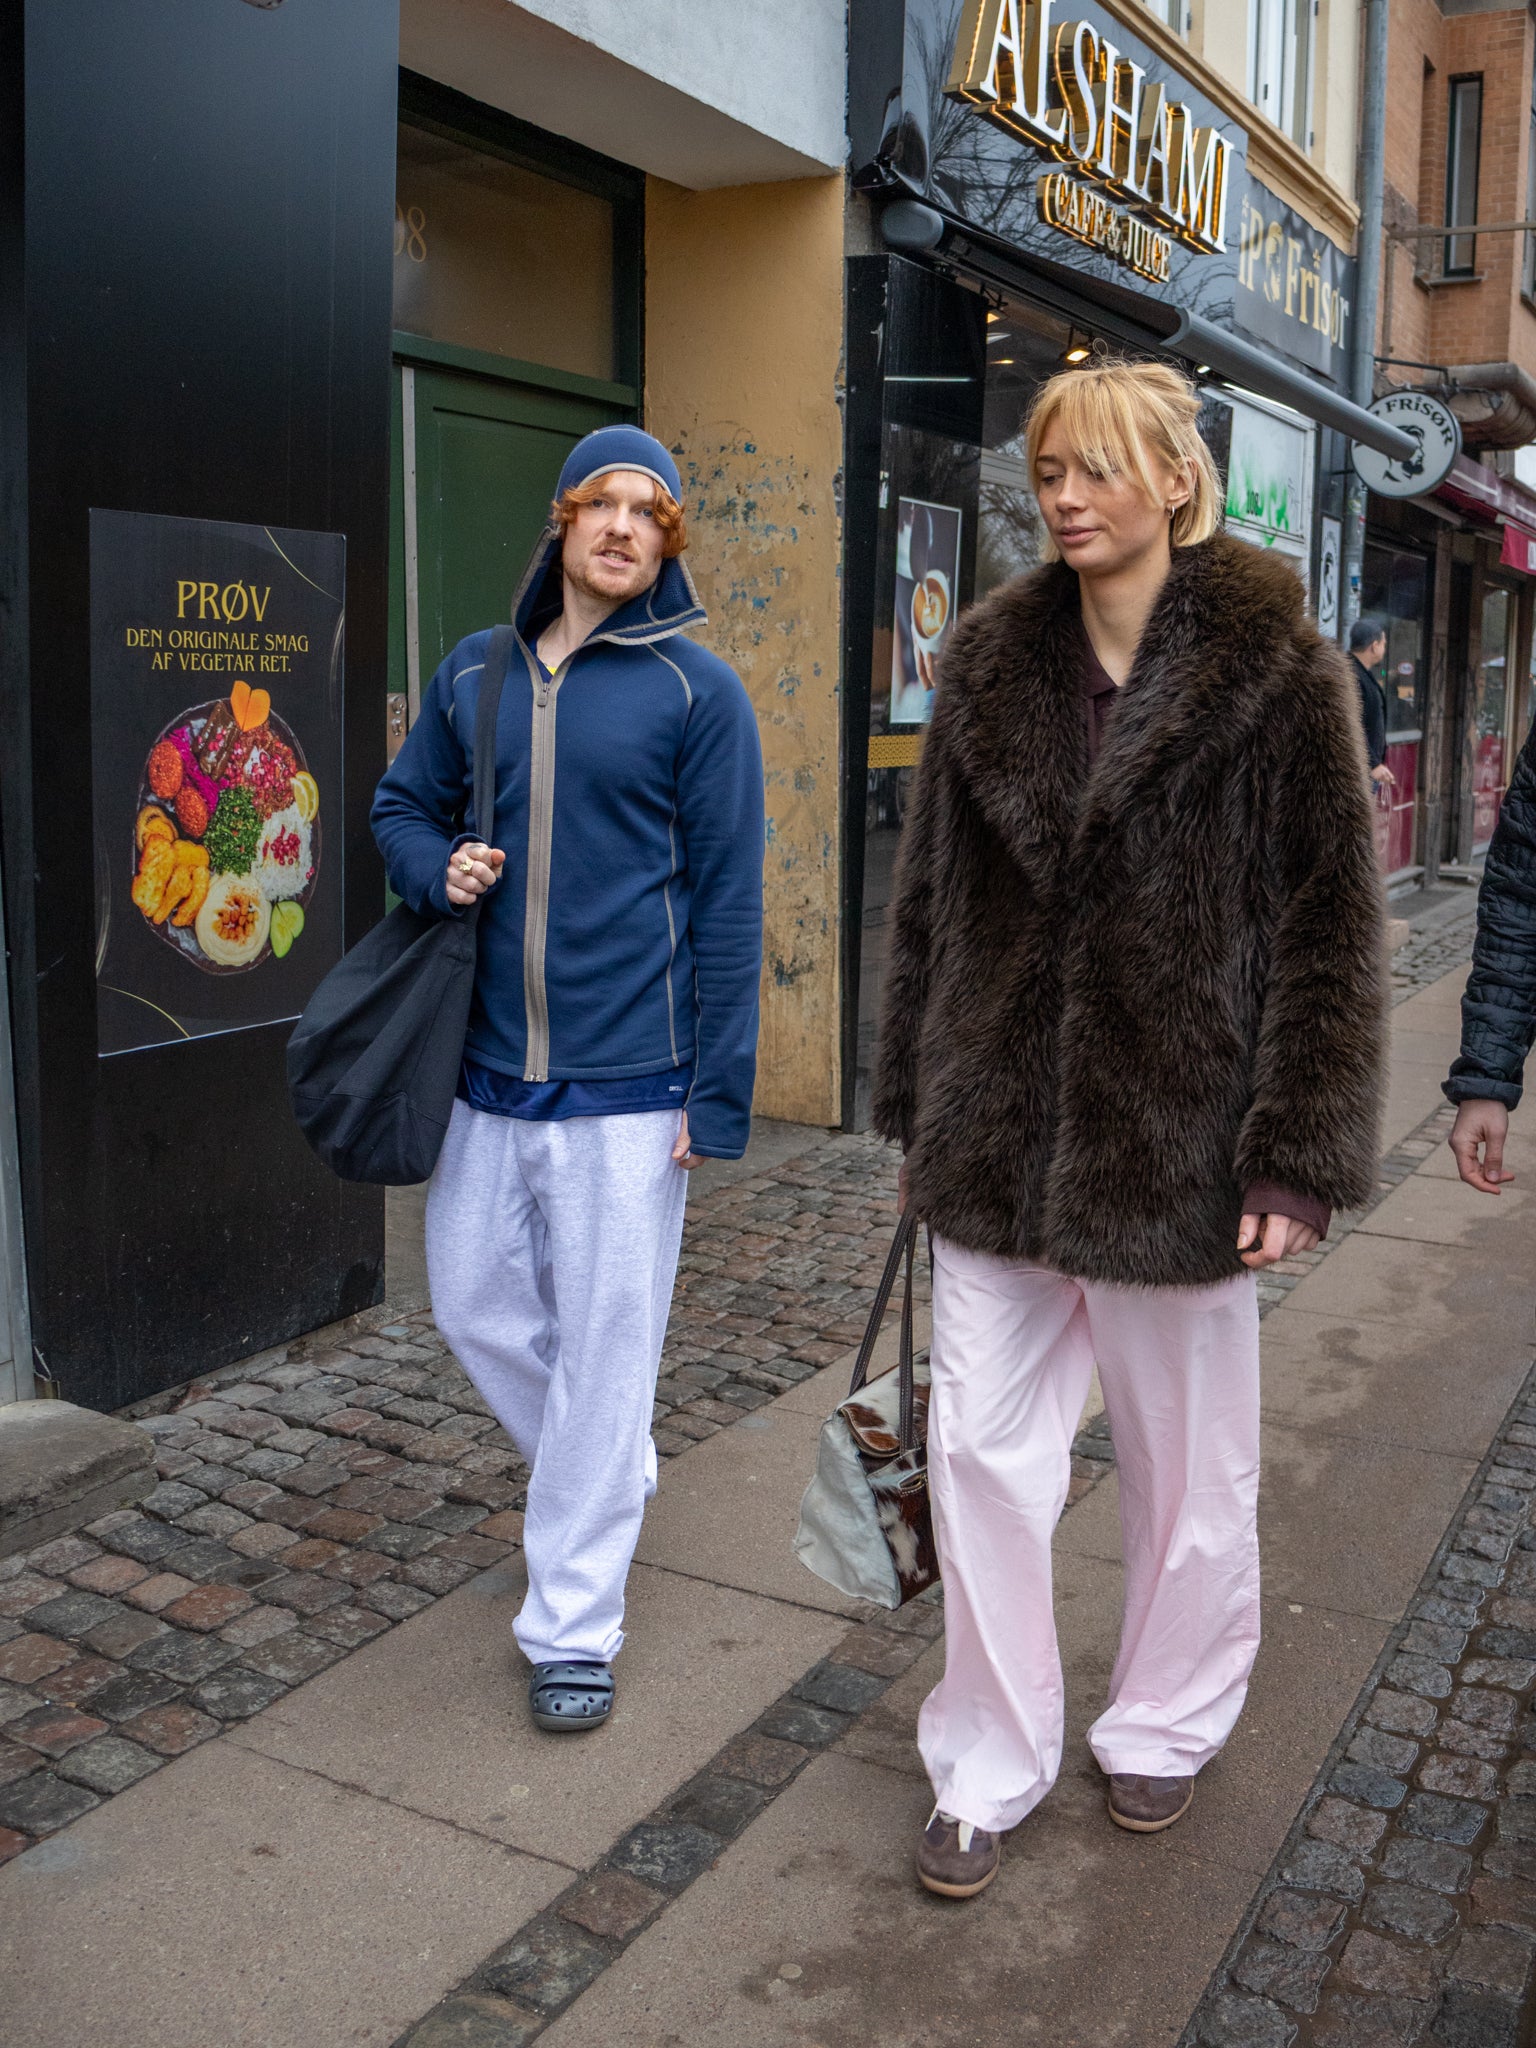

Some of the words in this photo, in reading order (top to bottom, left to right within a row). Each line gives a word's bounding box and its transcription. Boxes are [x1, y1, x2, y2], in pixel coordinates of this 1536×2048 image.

[979, 0, 1235, 254] ALSHAMI
[1054, 172, 1106, 246] CAFE
[1106, 208, 1121, 253] &
[1122, 215, 1172, 283] JUICE
[177, 580, 271, 624] PRØV
[126, 628, 162, 647] DEN
[168, 630, 260, 650] ORIGINALE
[264, 634, 309, 652] SMAG
[151, 652, 174, 670] AF
[178, 652, 255, 671] VEGETAR
[259, 655, 292, 672] RET.
